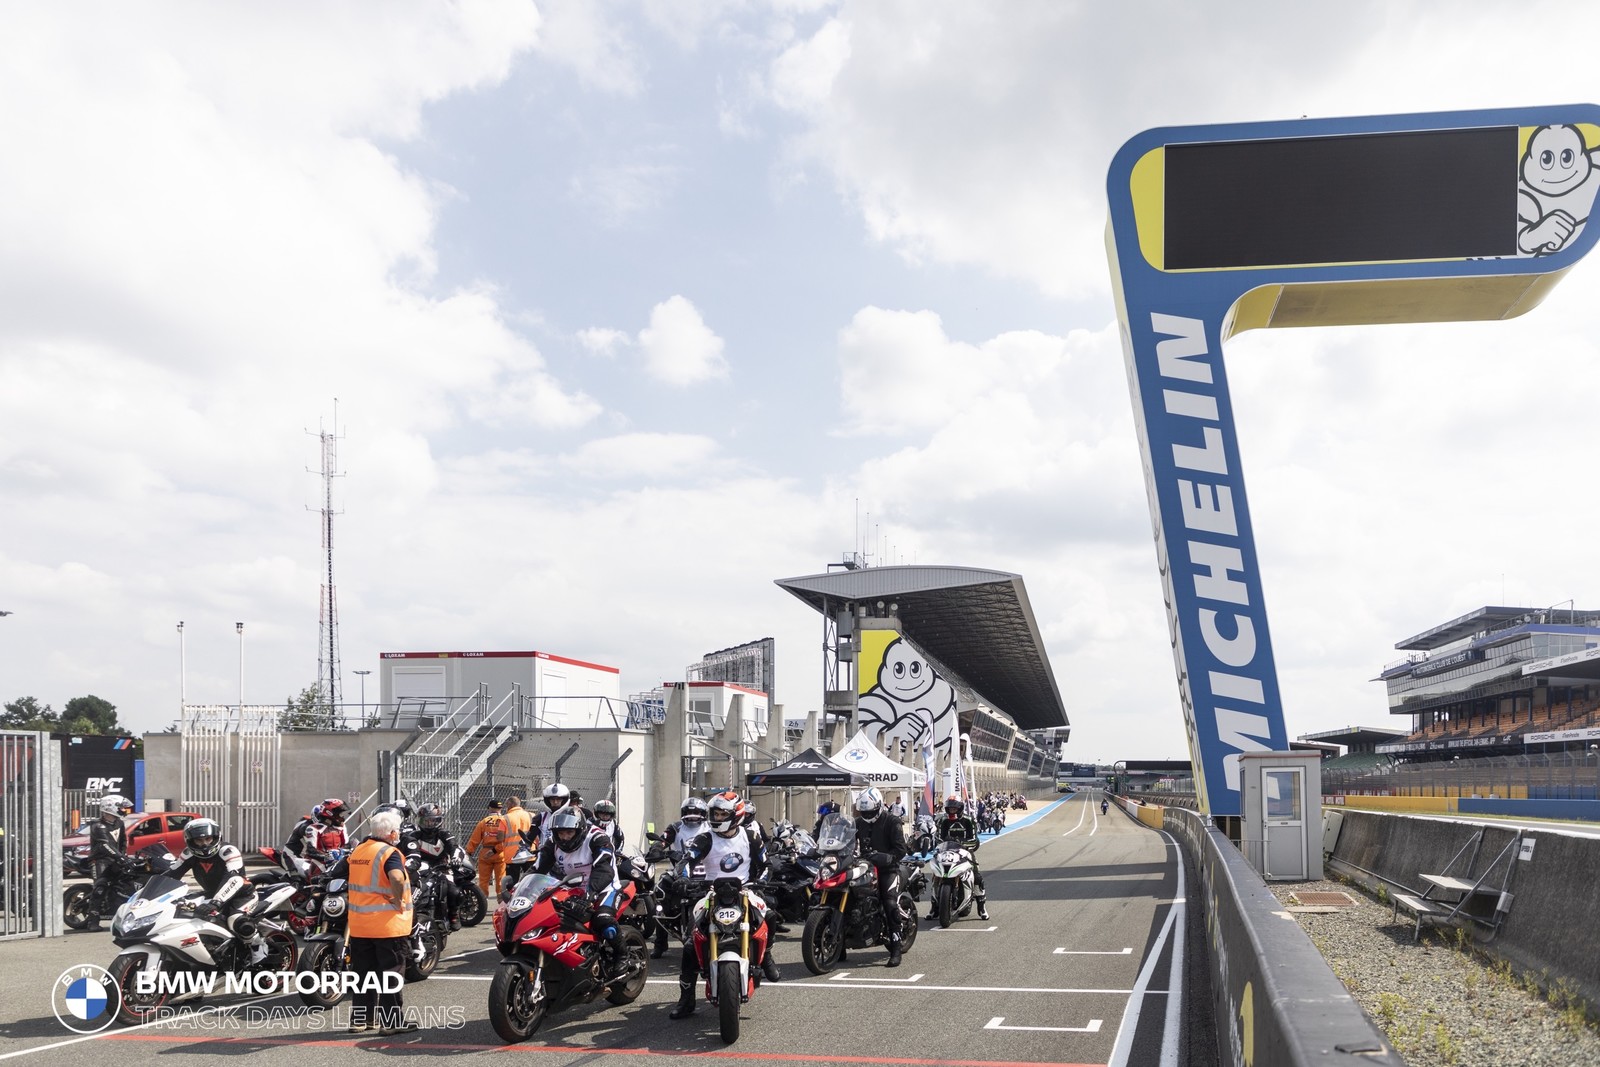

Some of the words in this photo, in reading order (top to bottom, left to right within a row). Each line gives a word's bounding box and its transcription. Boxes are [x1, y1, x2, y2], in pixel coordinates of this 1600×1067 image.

[1150, 311, 1281, 800] MICHELIN
[1530, 733, 1555, 741] PORSCHE
[868, 773, 899, 782] RRAD
[86, 777, 123, 793] BMC
[511, 898, 526, 907] 175
[719, 910, 735, 918] 212
